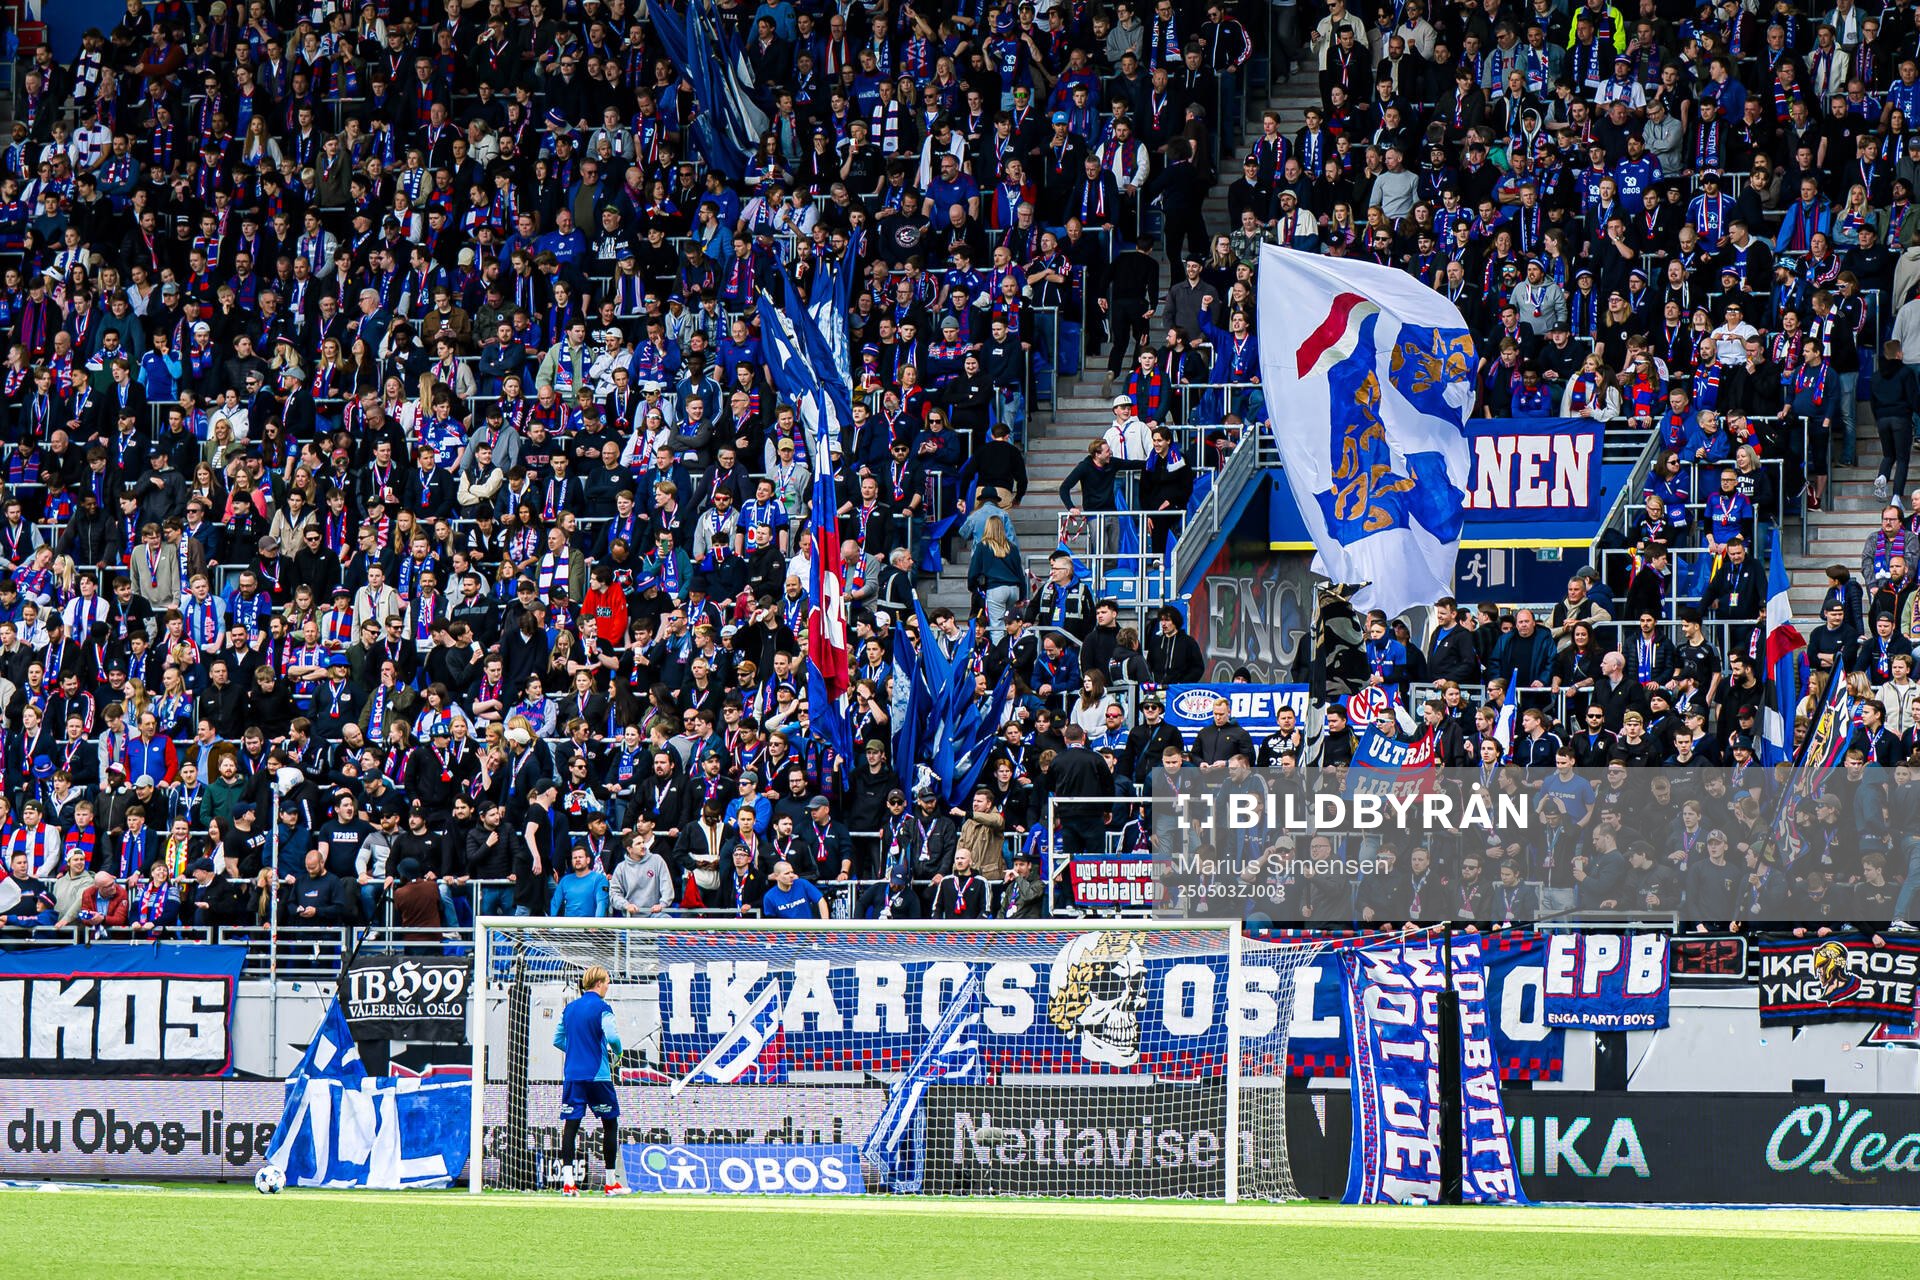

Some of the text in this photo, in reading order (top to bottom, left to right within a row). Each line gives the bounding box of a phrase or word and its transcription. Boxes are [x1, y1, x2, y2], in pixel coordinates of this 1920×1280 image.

[1463, 434, 1595, 508] NEN
[1368, 734, 1431, 766] ULTRAS
[1099, 860, 1119, 878] den
[1545, 933, 1667, 995] EPB
[1762, 949, 1919, 977] IKAROS
[426, 1003, 463, 1016] OSLO
[667, 960, 1037, 1036] IKAROS
[1548, 1013, 1655, 1026] ENGA PARTY BOYS
[8, 1108, 61, 1154] du
[1507, 1116, 1651, 1178] IKA
[718, 1156, 848, 1191] OBOS
